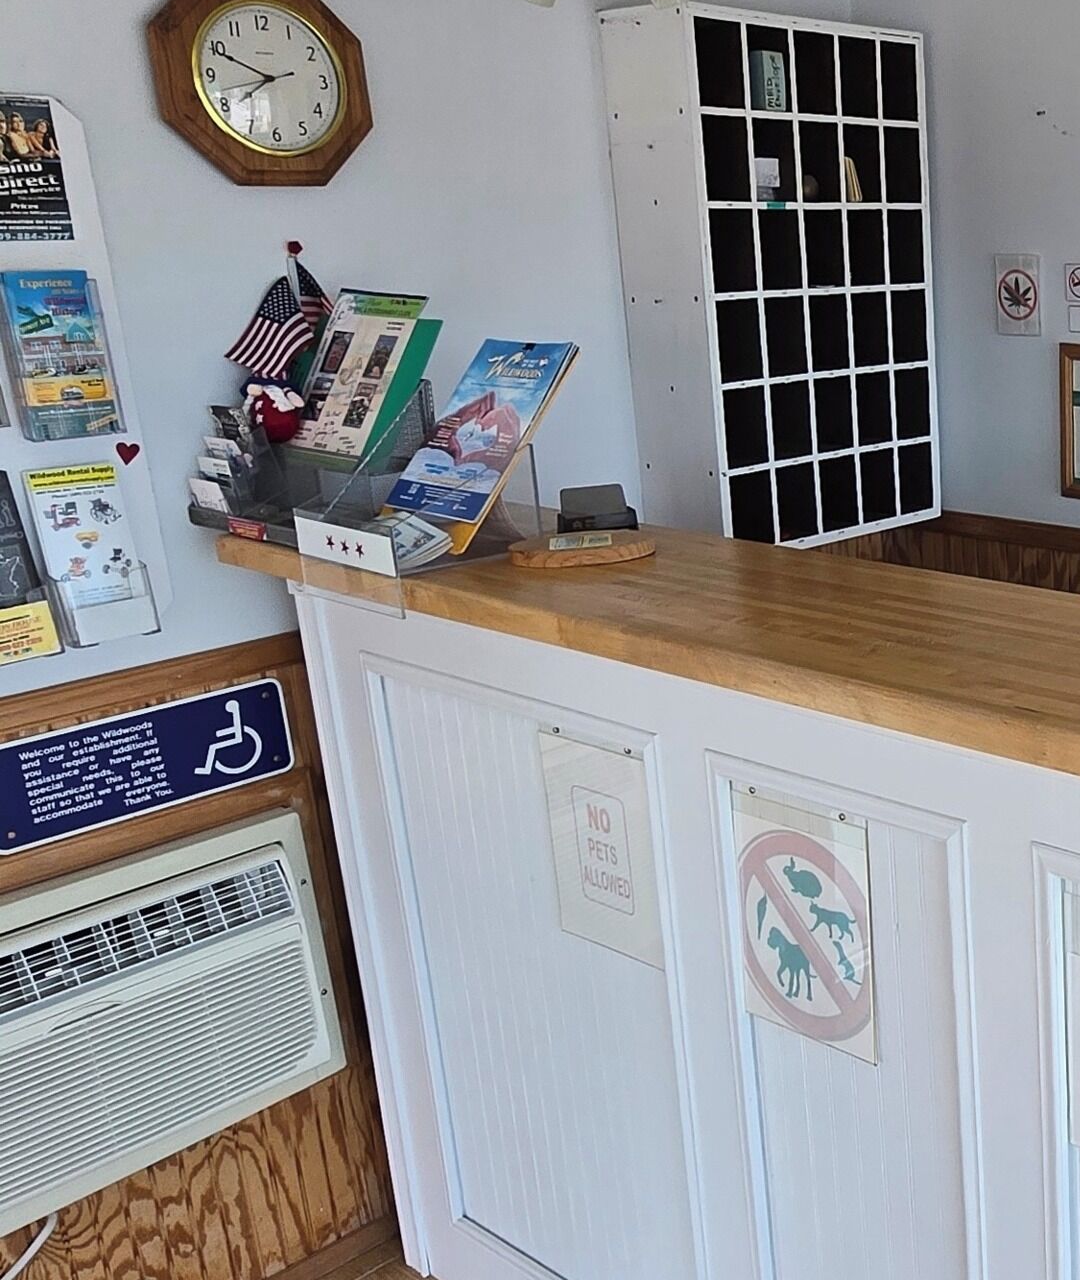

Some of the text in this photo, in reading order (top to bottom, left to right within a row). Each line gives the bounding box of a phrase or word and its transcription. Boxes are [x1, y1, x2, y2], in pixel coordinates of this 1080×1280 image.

[228, 21, 241, 37] 11
[254, 15, 270, 31] 12
[285, 25, 292, 40] 1
[209, 40, 226, 56] 10
[306, 46, 316, 62] 2
[205, 67, 216, 83] 9
[318, 75, 329, 90] 3
[219, 97, 230, 112] 8
[312, 102, 323, 118] 4
[247, 119, 255, 135] 7
[272, 127, 282, 142] 6
[298, 121, 308, 136] 5
[18, 278, 73, 289] Experience
[29, 470, 65, 479] Wildwood
[66, 467, 90, 476] Rental
[18, 721, 153, 761] Welcome to the Wildwoods
[21, 729, 153, 770] and our establishment. If
[23, 737, 158, 780] you require additional
[25, 747, 160, 788] assistance or have any
[27, 781, 64, 797] special
[131, 755, 162, 770] please
[29, 763, 165, 806] communicate this to our
[31, 801, 55, 815] staff
[59, 799, 72, 807] so
[75, 791, 94, 802] that
[97, 788, 112, 796] we
[115, 782, 130, 792] are
[133, 776, 153, 786] able
[33, 781, 170, 824] accommodate everyone.
[123, 788, 174, 806] Thank You.
[586, 802, 611, 834] NO
[587, 839, 618, 866] PETS
[583, 864, 631, 900] ALLOWED
